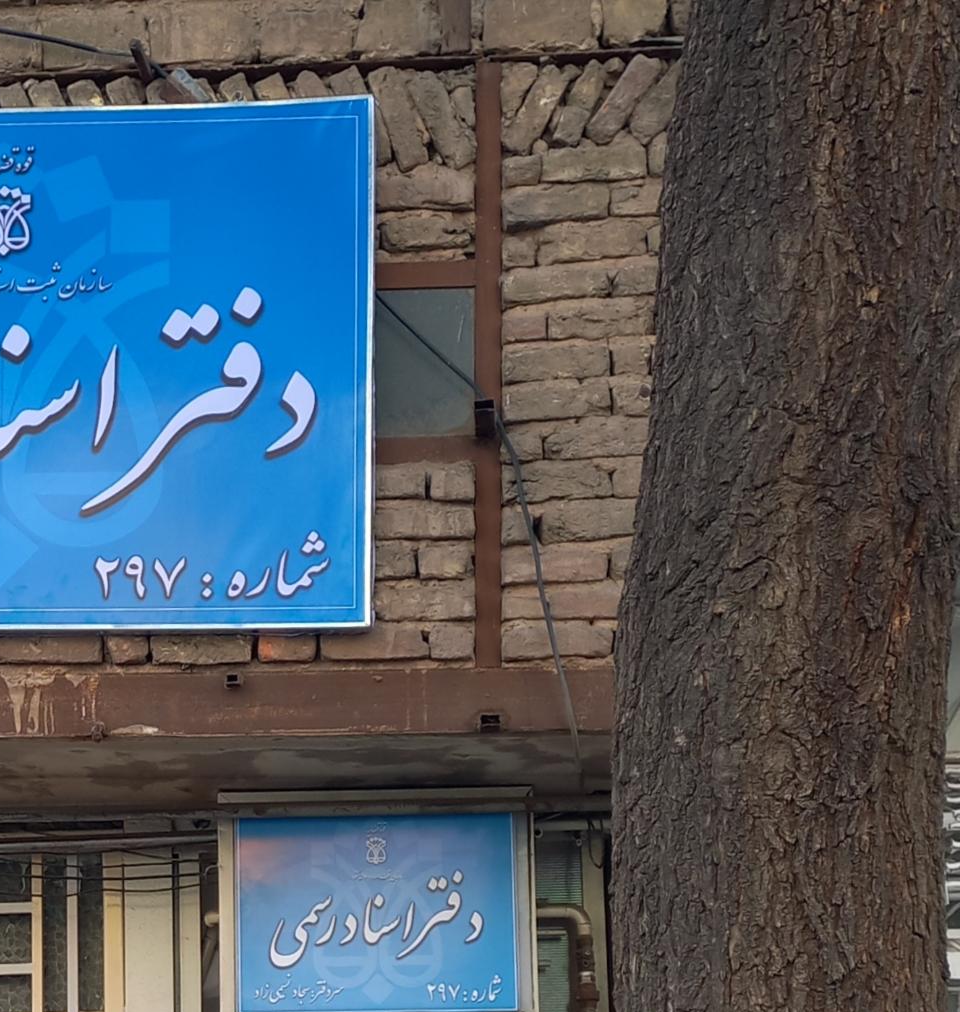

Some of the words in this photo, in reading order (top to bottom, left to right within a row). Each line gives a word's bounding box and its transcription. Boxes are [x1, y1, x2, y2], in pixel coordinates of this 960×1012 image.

[16, 262, 61, 301] ثبت
[58, 268, 112, 299] سازمان
[80, 286, 317, 516] دفتر
[94, 555, 187, 600] ۲۹۷
[269, 895, 337, 969] رسمی
[339, 894, 415, 945] اسناد
[395, 870, 484, 960] دفتر
[254, 984, 270, 999] زاد
[269, 973, 292, 1004] نسیمی
[292, 983, 312, 1004] سجاد
[427, 983, 460, 1001] ۲۹۷
